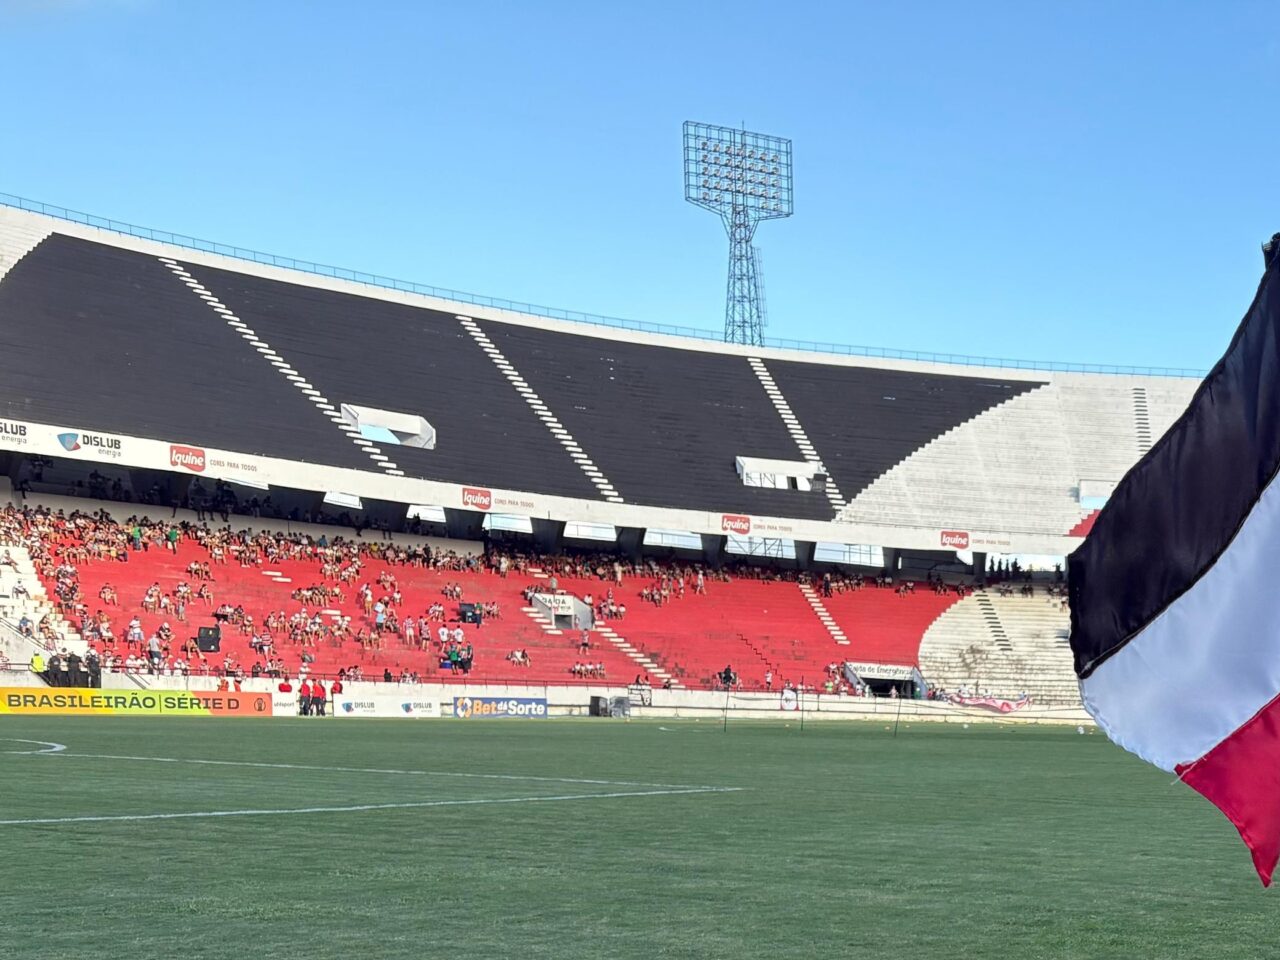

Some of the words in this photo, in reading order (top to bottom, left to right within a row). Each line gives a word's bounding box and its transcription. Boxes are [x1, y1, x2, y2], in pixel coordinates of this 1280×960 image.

[1, 435, 27, 445] energia
[82, 434, 121, 449] DISLUB
[98, 448, 121, 458] energia
[172, 450, 204, 468] Iquine
[227, 462, 240, 470] PARA
[241, 463, 257, 472] TODOS
[463, 491, 490, 506] Iquine
[722, 518, 749, 532] Iquine
[942, 534, 968, 546] Iquine
[7, 692, 156, 709] BRASILEIRÃO
[164, 694, 223, 710] SÉRIE
[227, 698, 240, 709] D
[473, 700, 497, 715] Bet
[507, 700, 545, 715] Sorte
